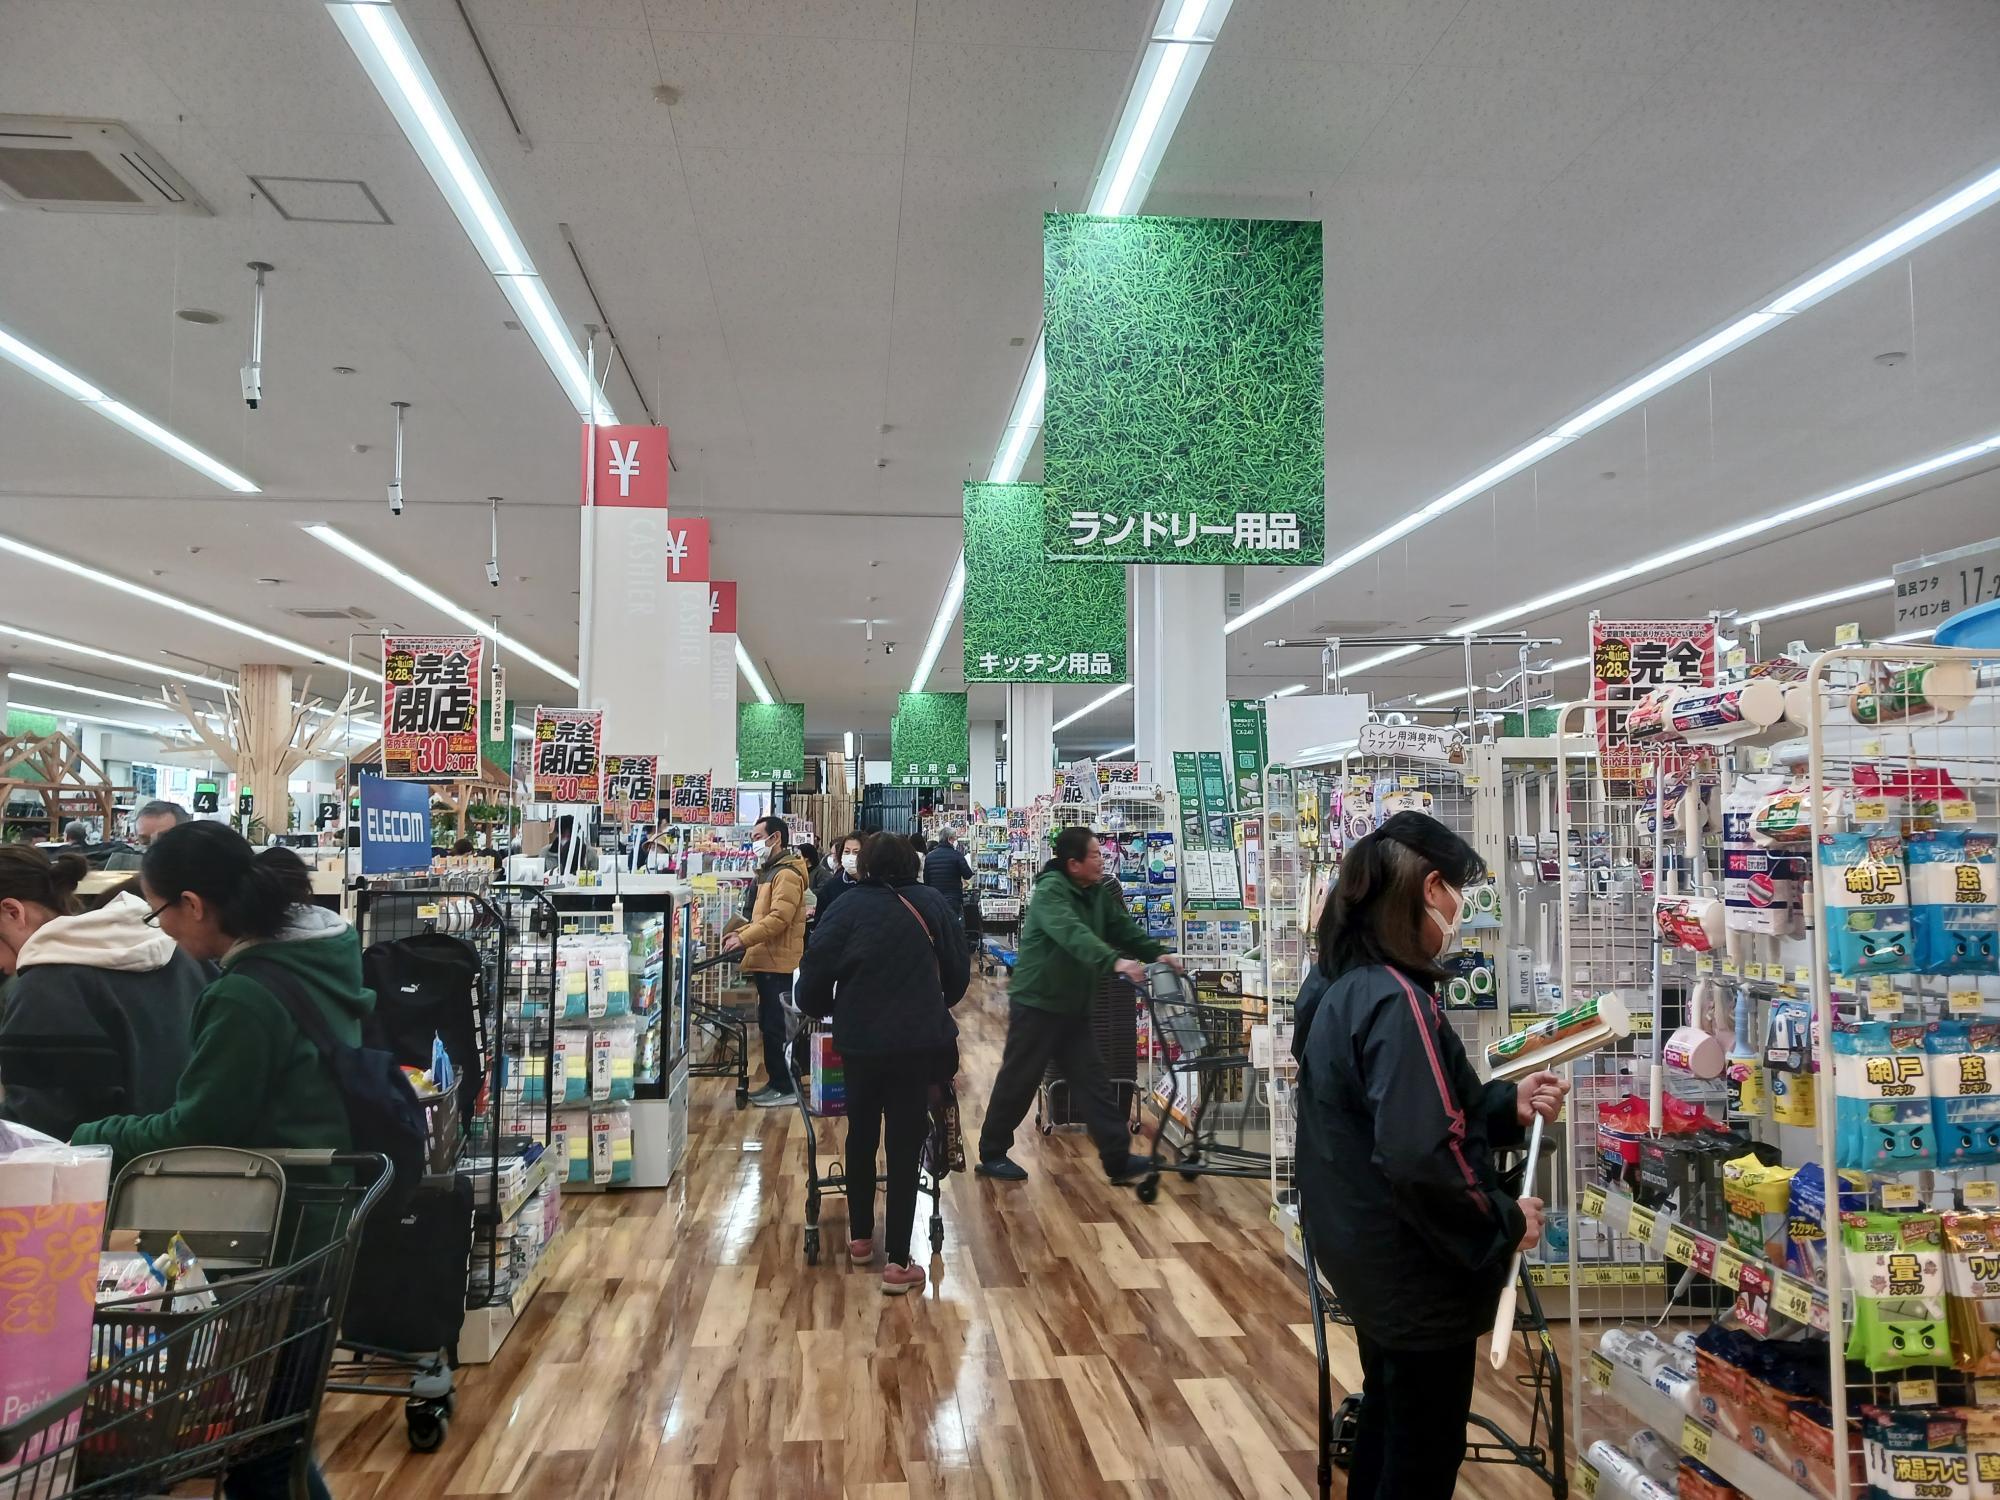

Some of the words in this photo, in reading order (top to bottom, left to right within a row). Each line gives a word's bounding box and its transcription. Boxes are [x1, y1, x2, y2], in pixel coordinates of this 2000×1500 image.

[1069, 511, 1300, 550] ランドリー用品
[626, 516, 658, 616] CASHIER
[1898, 577, 1939, 598] 風呂フタ
[1898, 600, 1951, 621] アイロン台
[414, 652, 471, 686] 完全
[979, 652, 1112, 675] キッチン用品
[1631, 641, 1704, 684] 完全
[391, 686, 473, 734] 閉店
[463, 705, 477, 731] セール
[555, 722, 595, 744] 完全
[1368, 729, 1437, 744] トイレ用消臭剤
[1368, 740, 1427, 752] ファブリーズ
[539, 744, 596, 775] 閉店
[620, 758, 652, 775] 完全
[908, 763, 958, 774] 日用品
[684, 774, 707, 788] 完全
[750, 769, 793, 780] カー用品
[902, 776, 941, 786] 事務用品
[1110, 769, 1134, 783] 完全
[197, 795, 210, 809] 4
[673, 787, 708, 808] 閉店
[323, 806, 333, 818] 2
[367, 808, 425, 843] ELECOM
[1845, 865, 1903, 893] 網戸
[1955, 865, 1981, 891] 窓
[1866, 1056, 1924, 1084] 網戸
[1959, 1055, 1987, 1082] 窓
[1788, 1222, 1819, 1237] スカット
[1865, 1232, 1895, 1242] バルサン
[1888, 1254, 1922, 1284] 畳
[1968, 1255, 2000, 1281] ワッ
[1790, 1296, 1807, 1314] 698
[1892, 1455, 1969, 1485] 液晶テレビ
